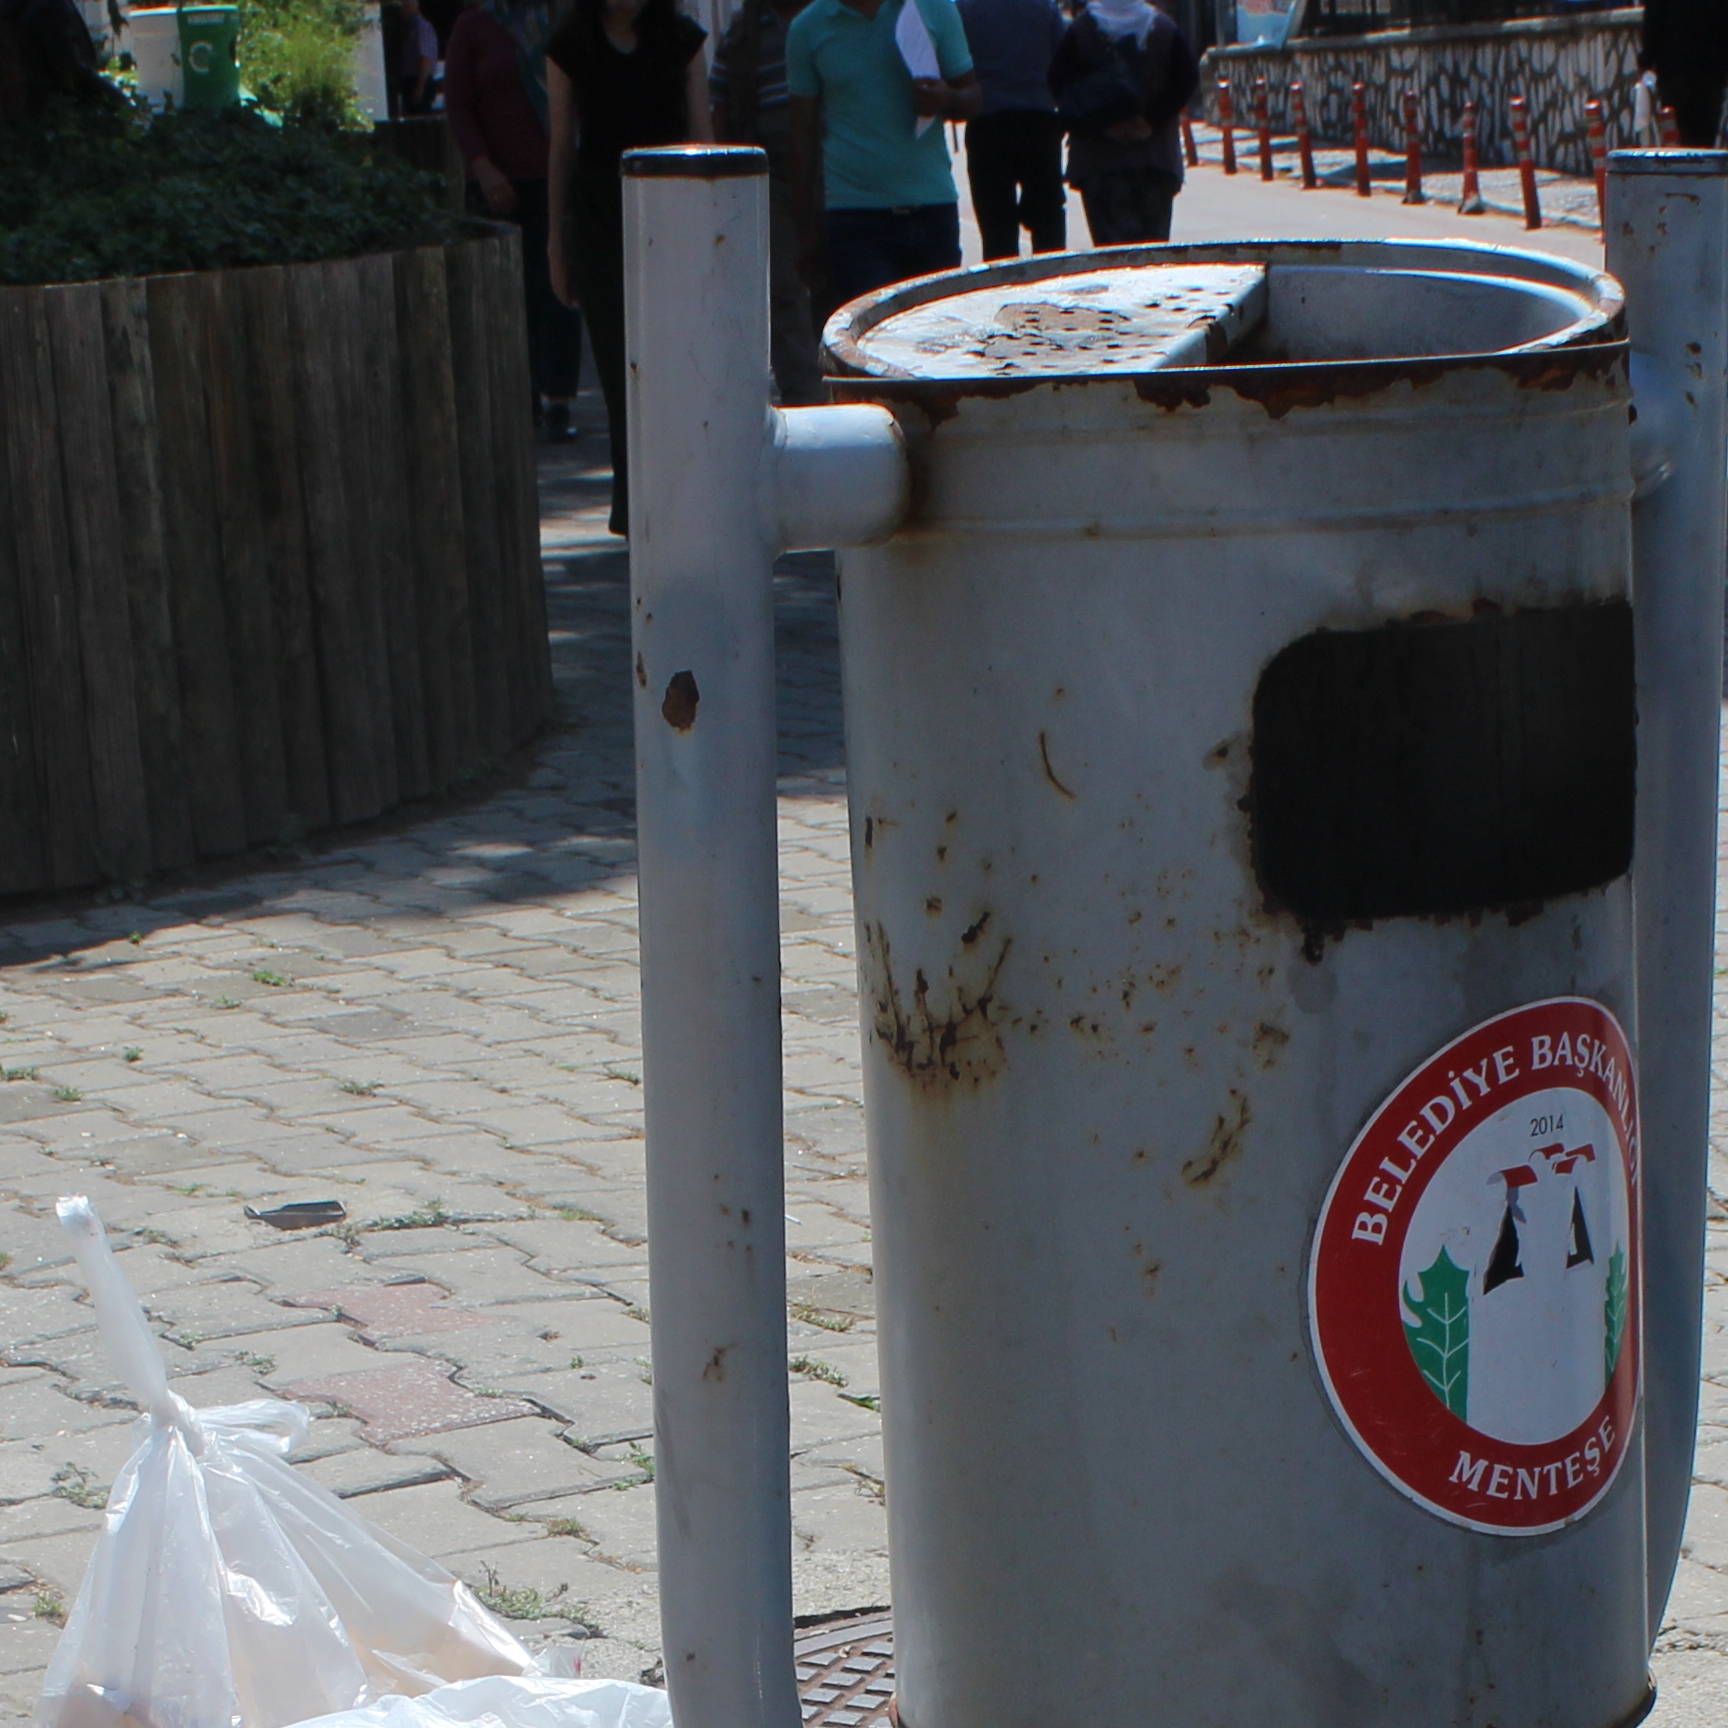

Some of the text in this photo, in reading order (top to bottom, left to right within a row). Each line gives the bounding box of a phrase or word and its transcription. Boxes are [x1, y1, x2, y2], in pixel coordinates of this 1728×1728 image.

[1351, 1044, 1520, 1246] BELEDİYE
[1530, 1114, 1564, 1137] 2014
[1448, 1414, 1617, 1501] MENTEŞE
